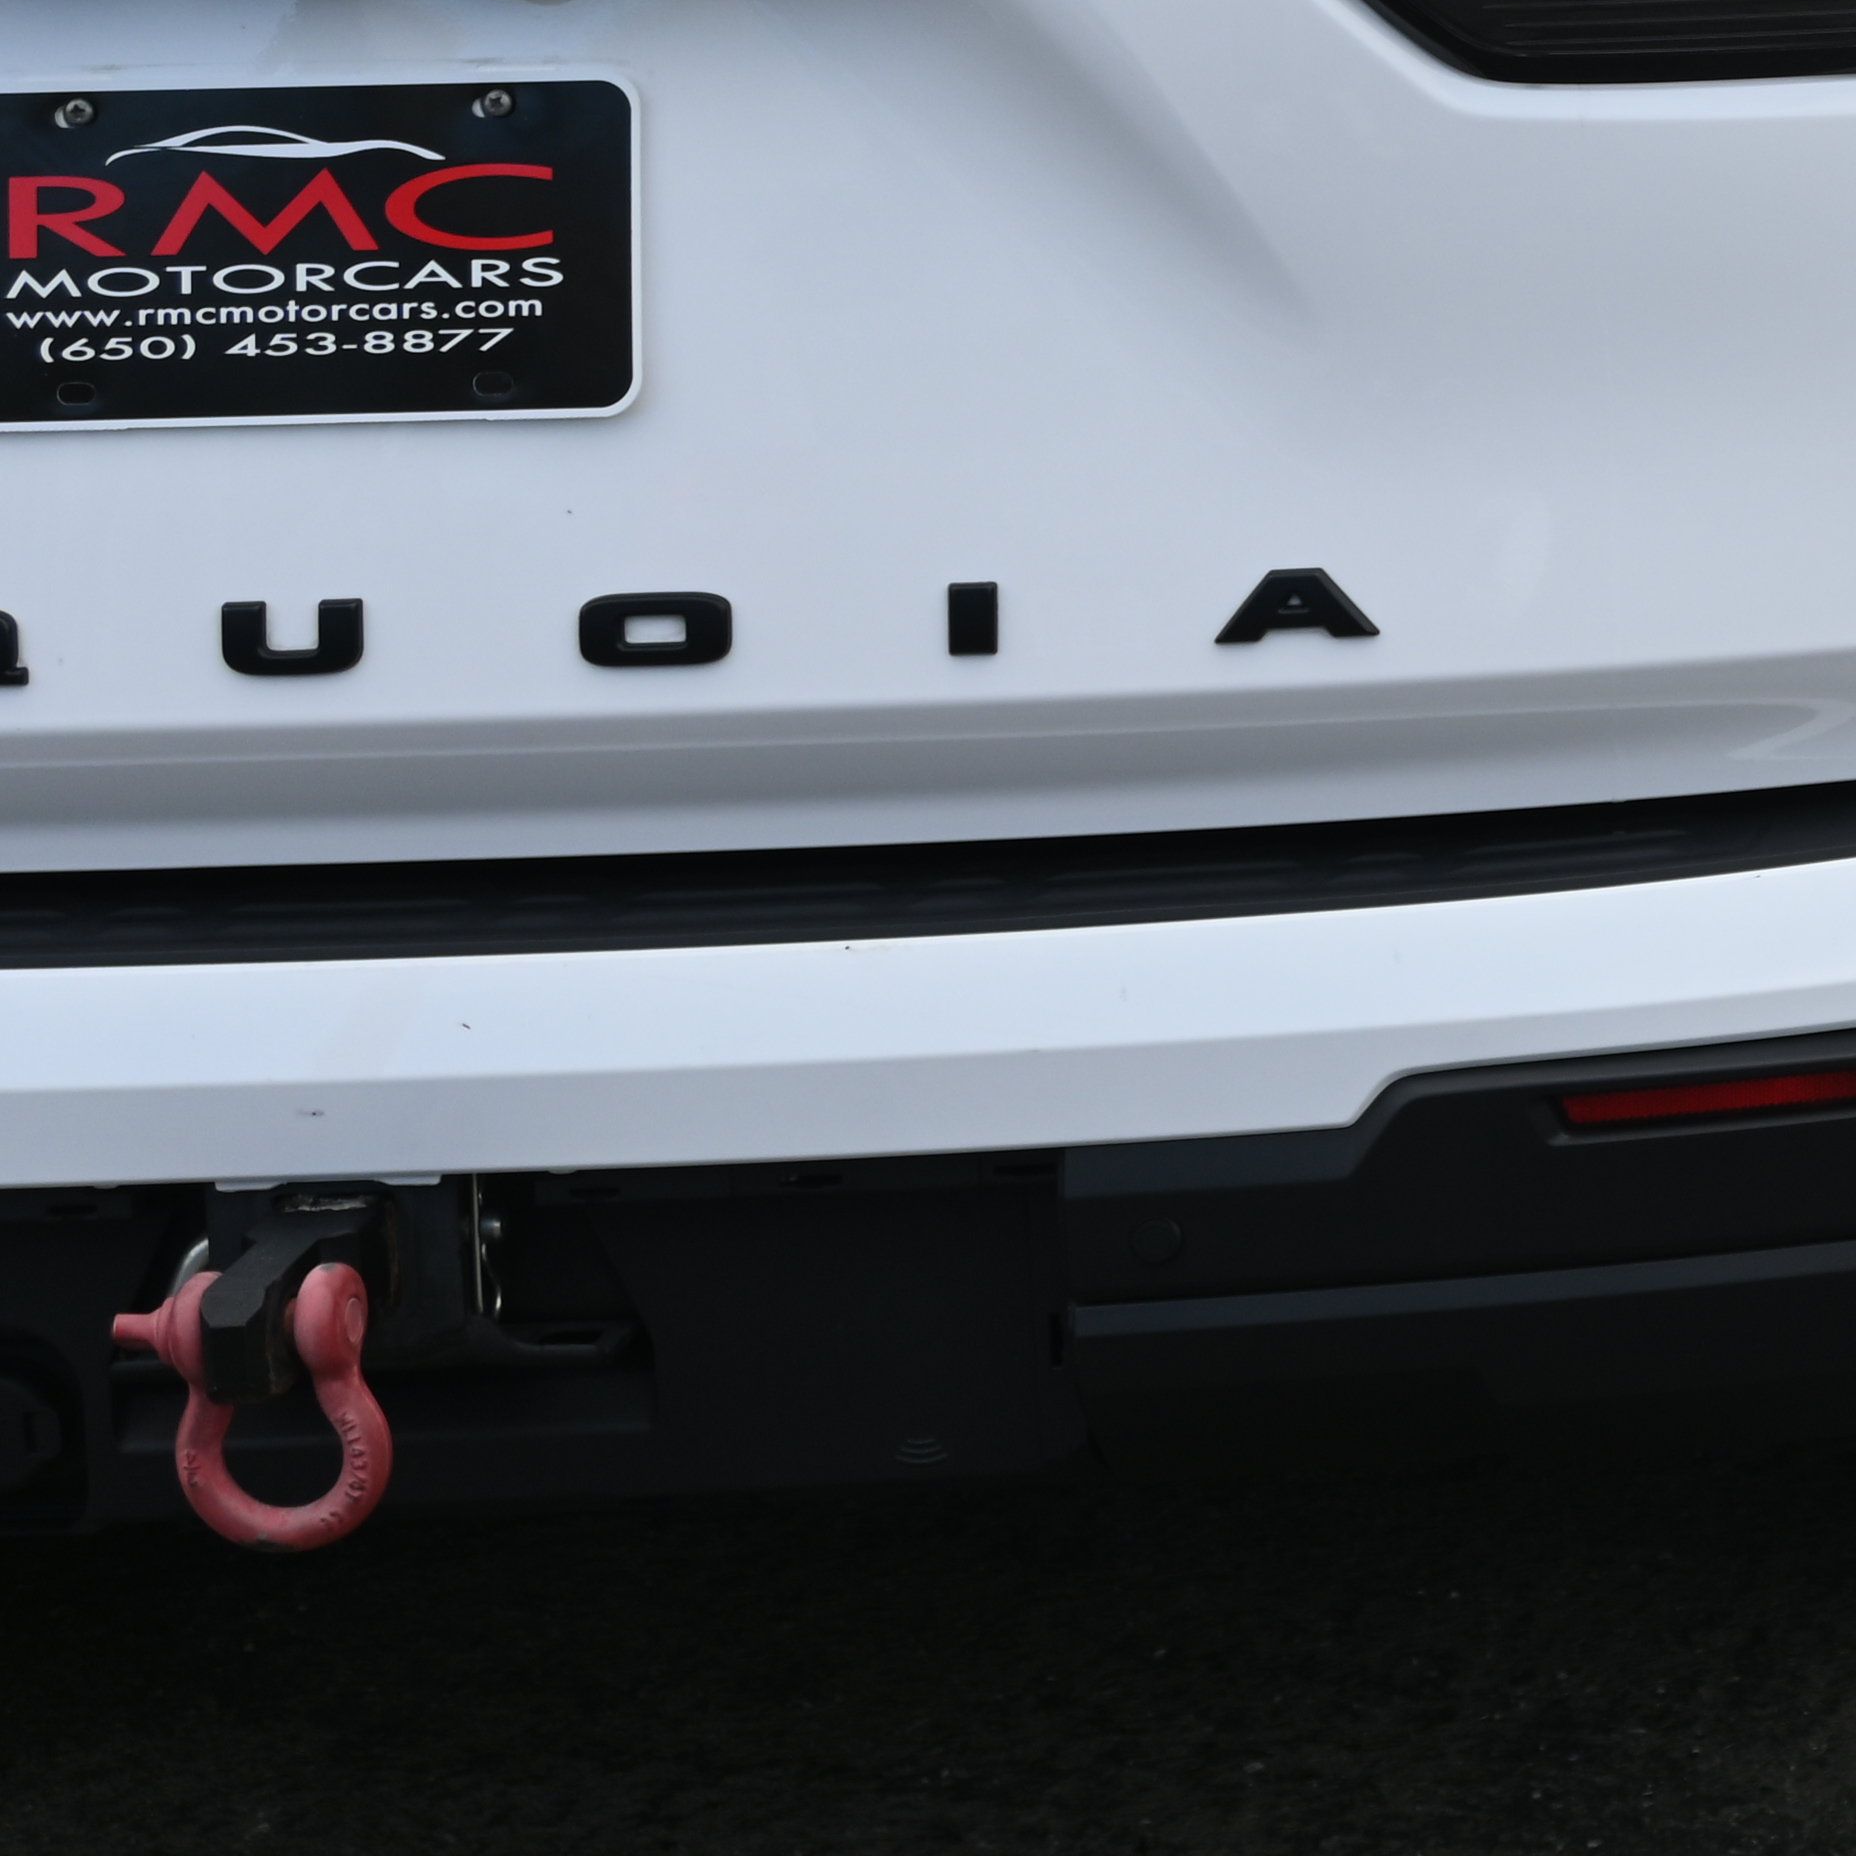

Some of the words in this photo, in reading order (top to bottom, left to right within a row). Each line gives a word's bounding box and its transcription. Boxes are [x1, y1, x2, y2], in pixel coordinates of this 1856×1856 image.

[9, 163, 554, 259] RMC
[6, 257, 564, 299] MOTORCARS
[6, 298, 543, 330] www.rmcmotorcars.com
[40, 334, 196, 363] (650)
[225, 328, 514, 357] 453-8877
[0, 567, 1381, 687] UOIA
